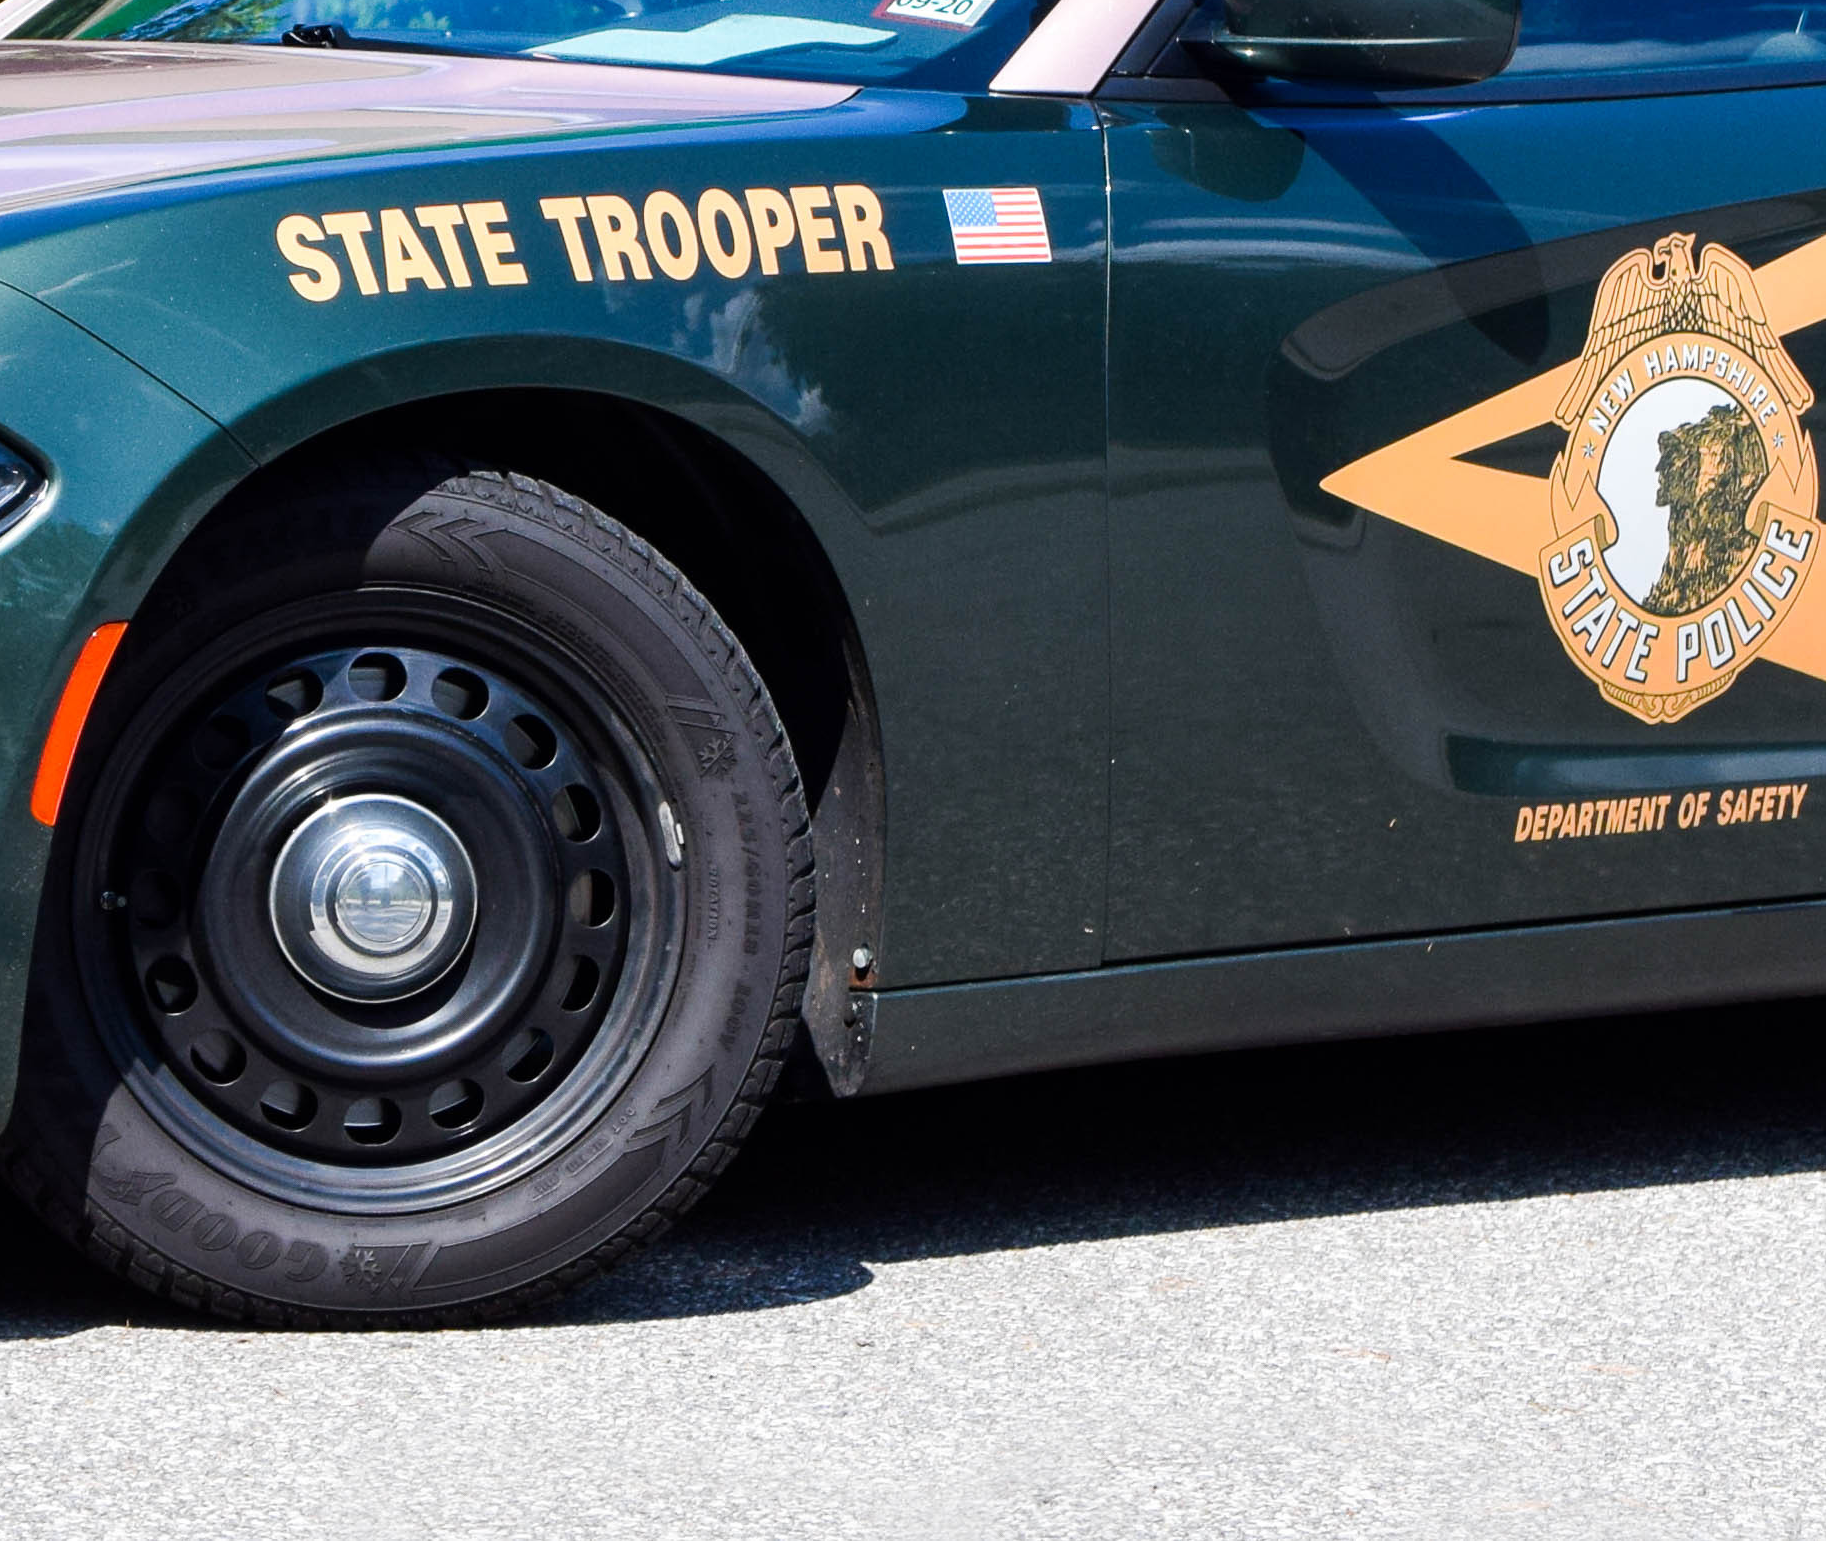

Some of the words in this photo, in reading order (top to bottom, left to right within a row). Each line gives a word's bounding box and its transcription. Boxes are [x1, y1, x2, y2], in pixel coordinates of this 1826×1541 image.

[275, 200, 529, 304] STATE
[539, 182, 895, 284] TROOPER
[1588, 368, 1635, 435] NEW
[1644, 344, 1779, 427] HAMPSHIRE
[1549, 537, 1660, 683] STATE
[1677, 519, 1813, 683] POLICE
[1514, 794, 1672, 843] DEPARTMENT
[1677, 791, 1712, 829] OF
[1717, 783, 1808, 827] SAFETY
